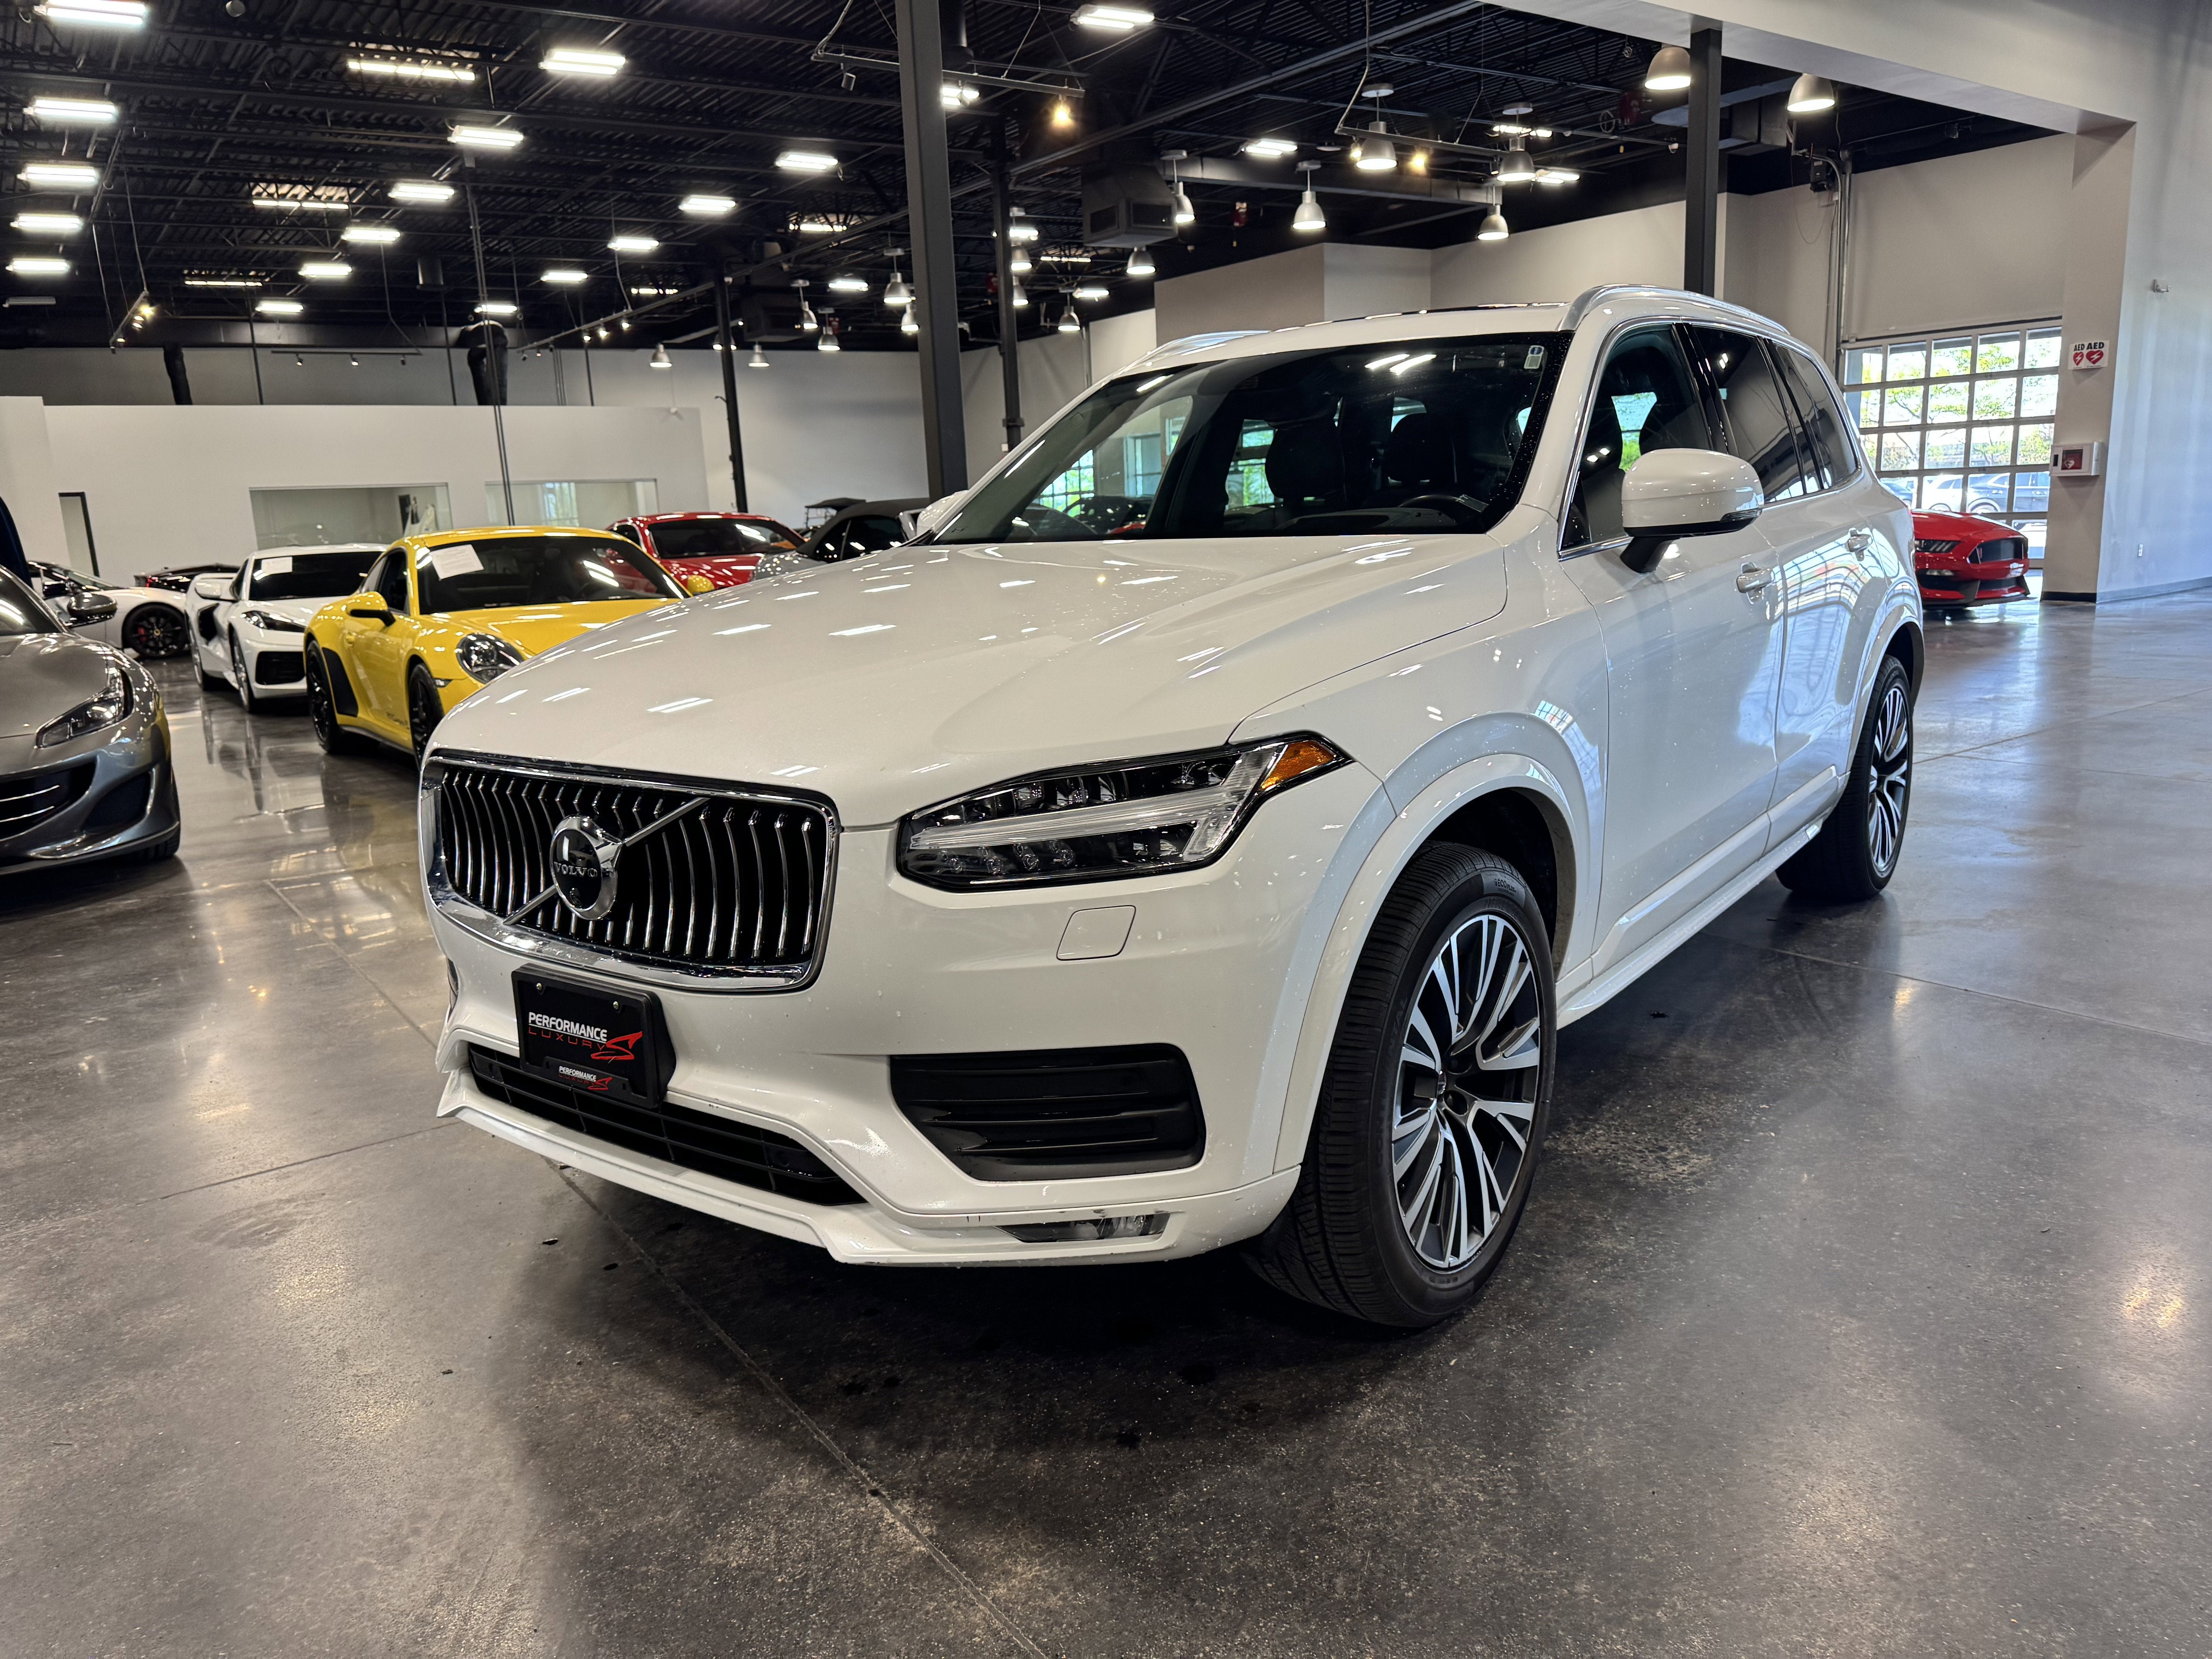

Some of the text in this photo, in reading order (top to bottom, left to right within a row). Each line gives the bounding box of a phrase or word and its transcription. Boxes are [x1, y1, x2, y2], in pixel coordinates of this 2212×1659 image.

[2074, 343, 2085, 352] AED
[2086, 342, 2104, 350] AED
[554, 862, 598, 877] VOLVO
[529, 1012, 607, 1041] PERFORMANCE
[528, 1027, 605, 1051] LUXURY
[559, 1066, 596, 1082] PERFORMANCE
